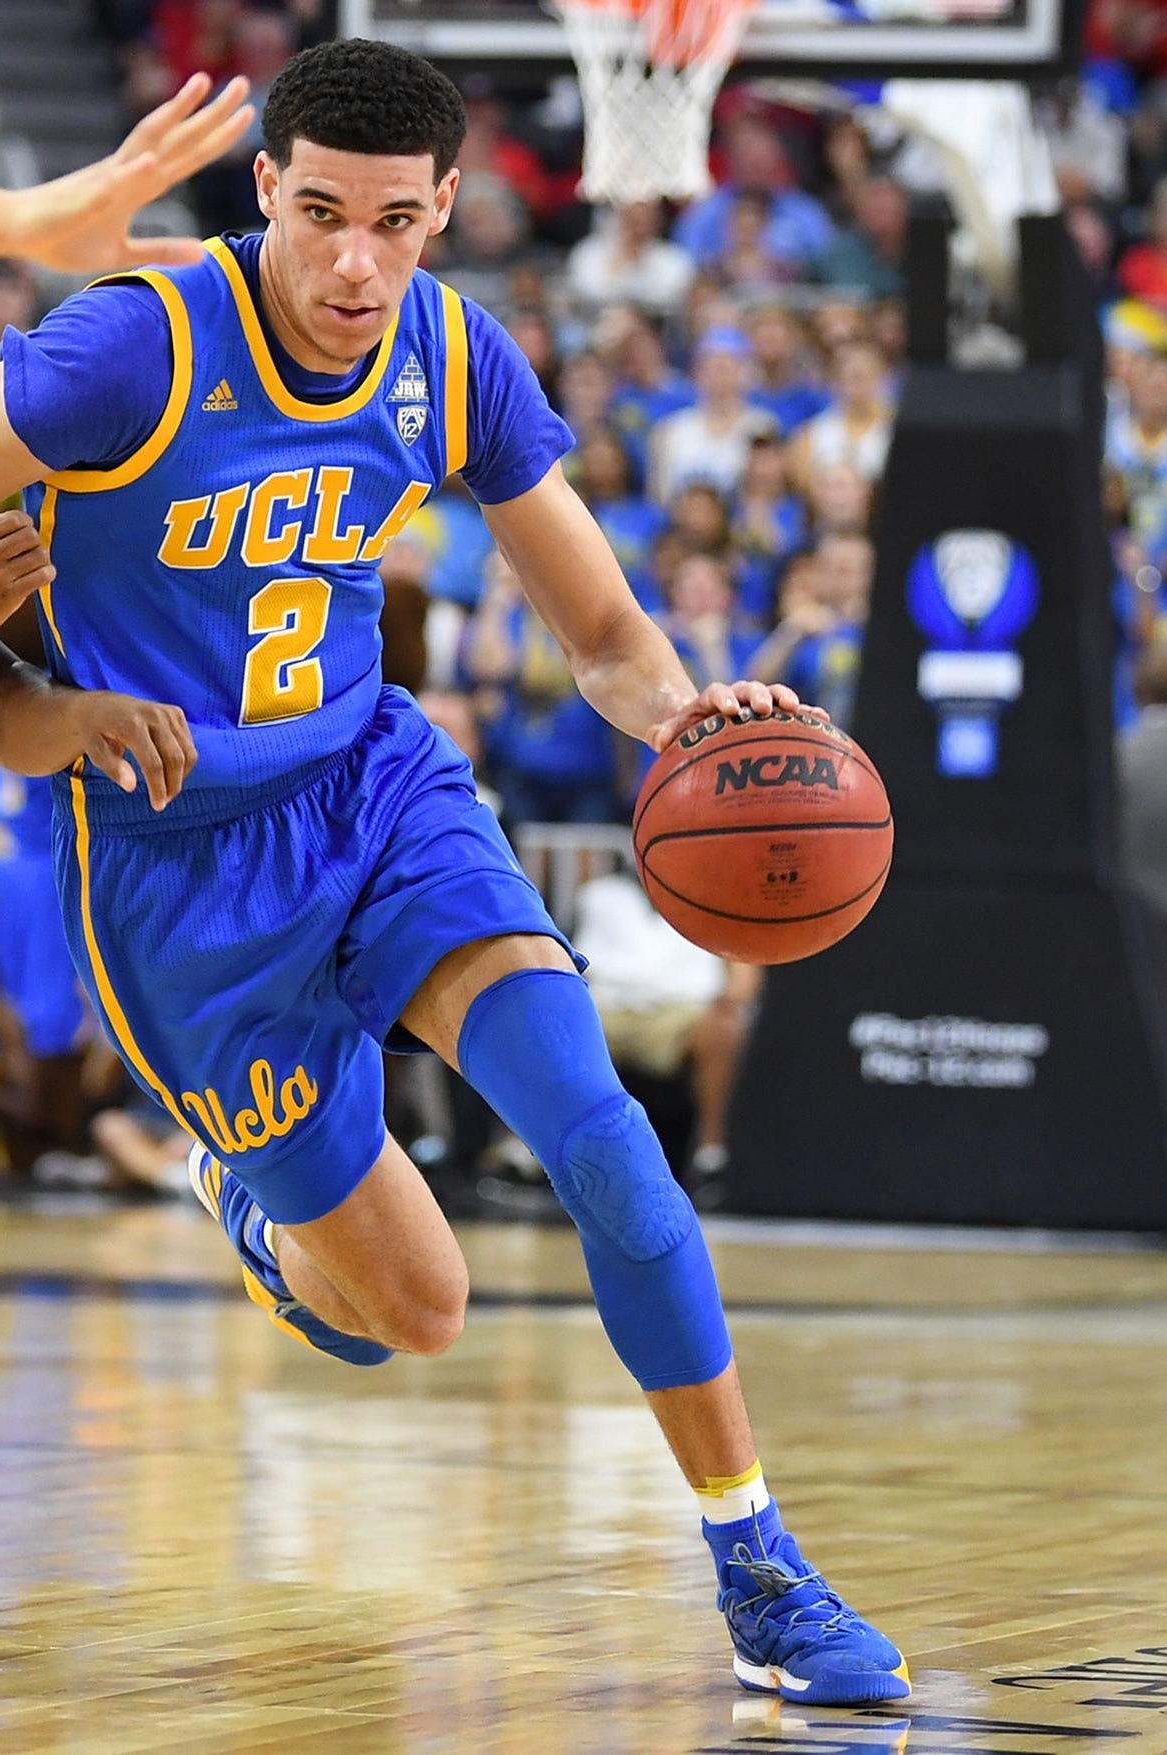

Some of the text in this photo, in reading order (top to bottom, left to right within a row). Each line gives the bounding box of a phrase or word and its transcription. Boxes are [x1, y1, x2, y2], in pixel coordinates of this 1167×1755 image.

[201, 400, 238, 411] adidas
[395, 382, 426, 397] JRW
[404, 423, 418, 438] 12
[157, 466, 432, 570] UCLA
[237, 576, 333, 728] 2
[715, 755, 839, 796] NCAA
[181, 1058, 318, 1154] Ucla
